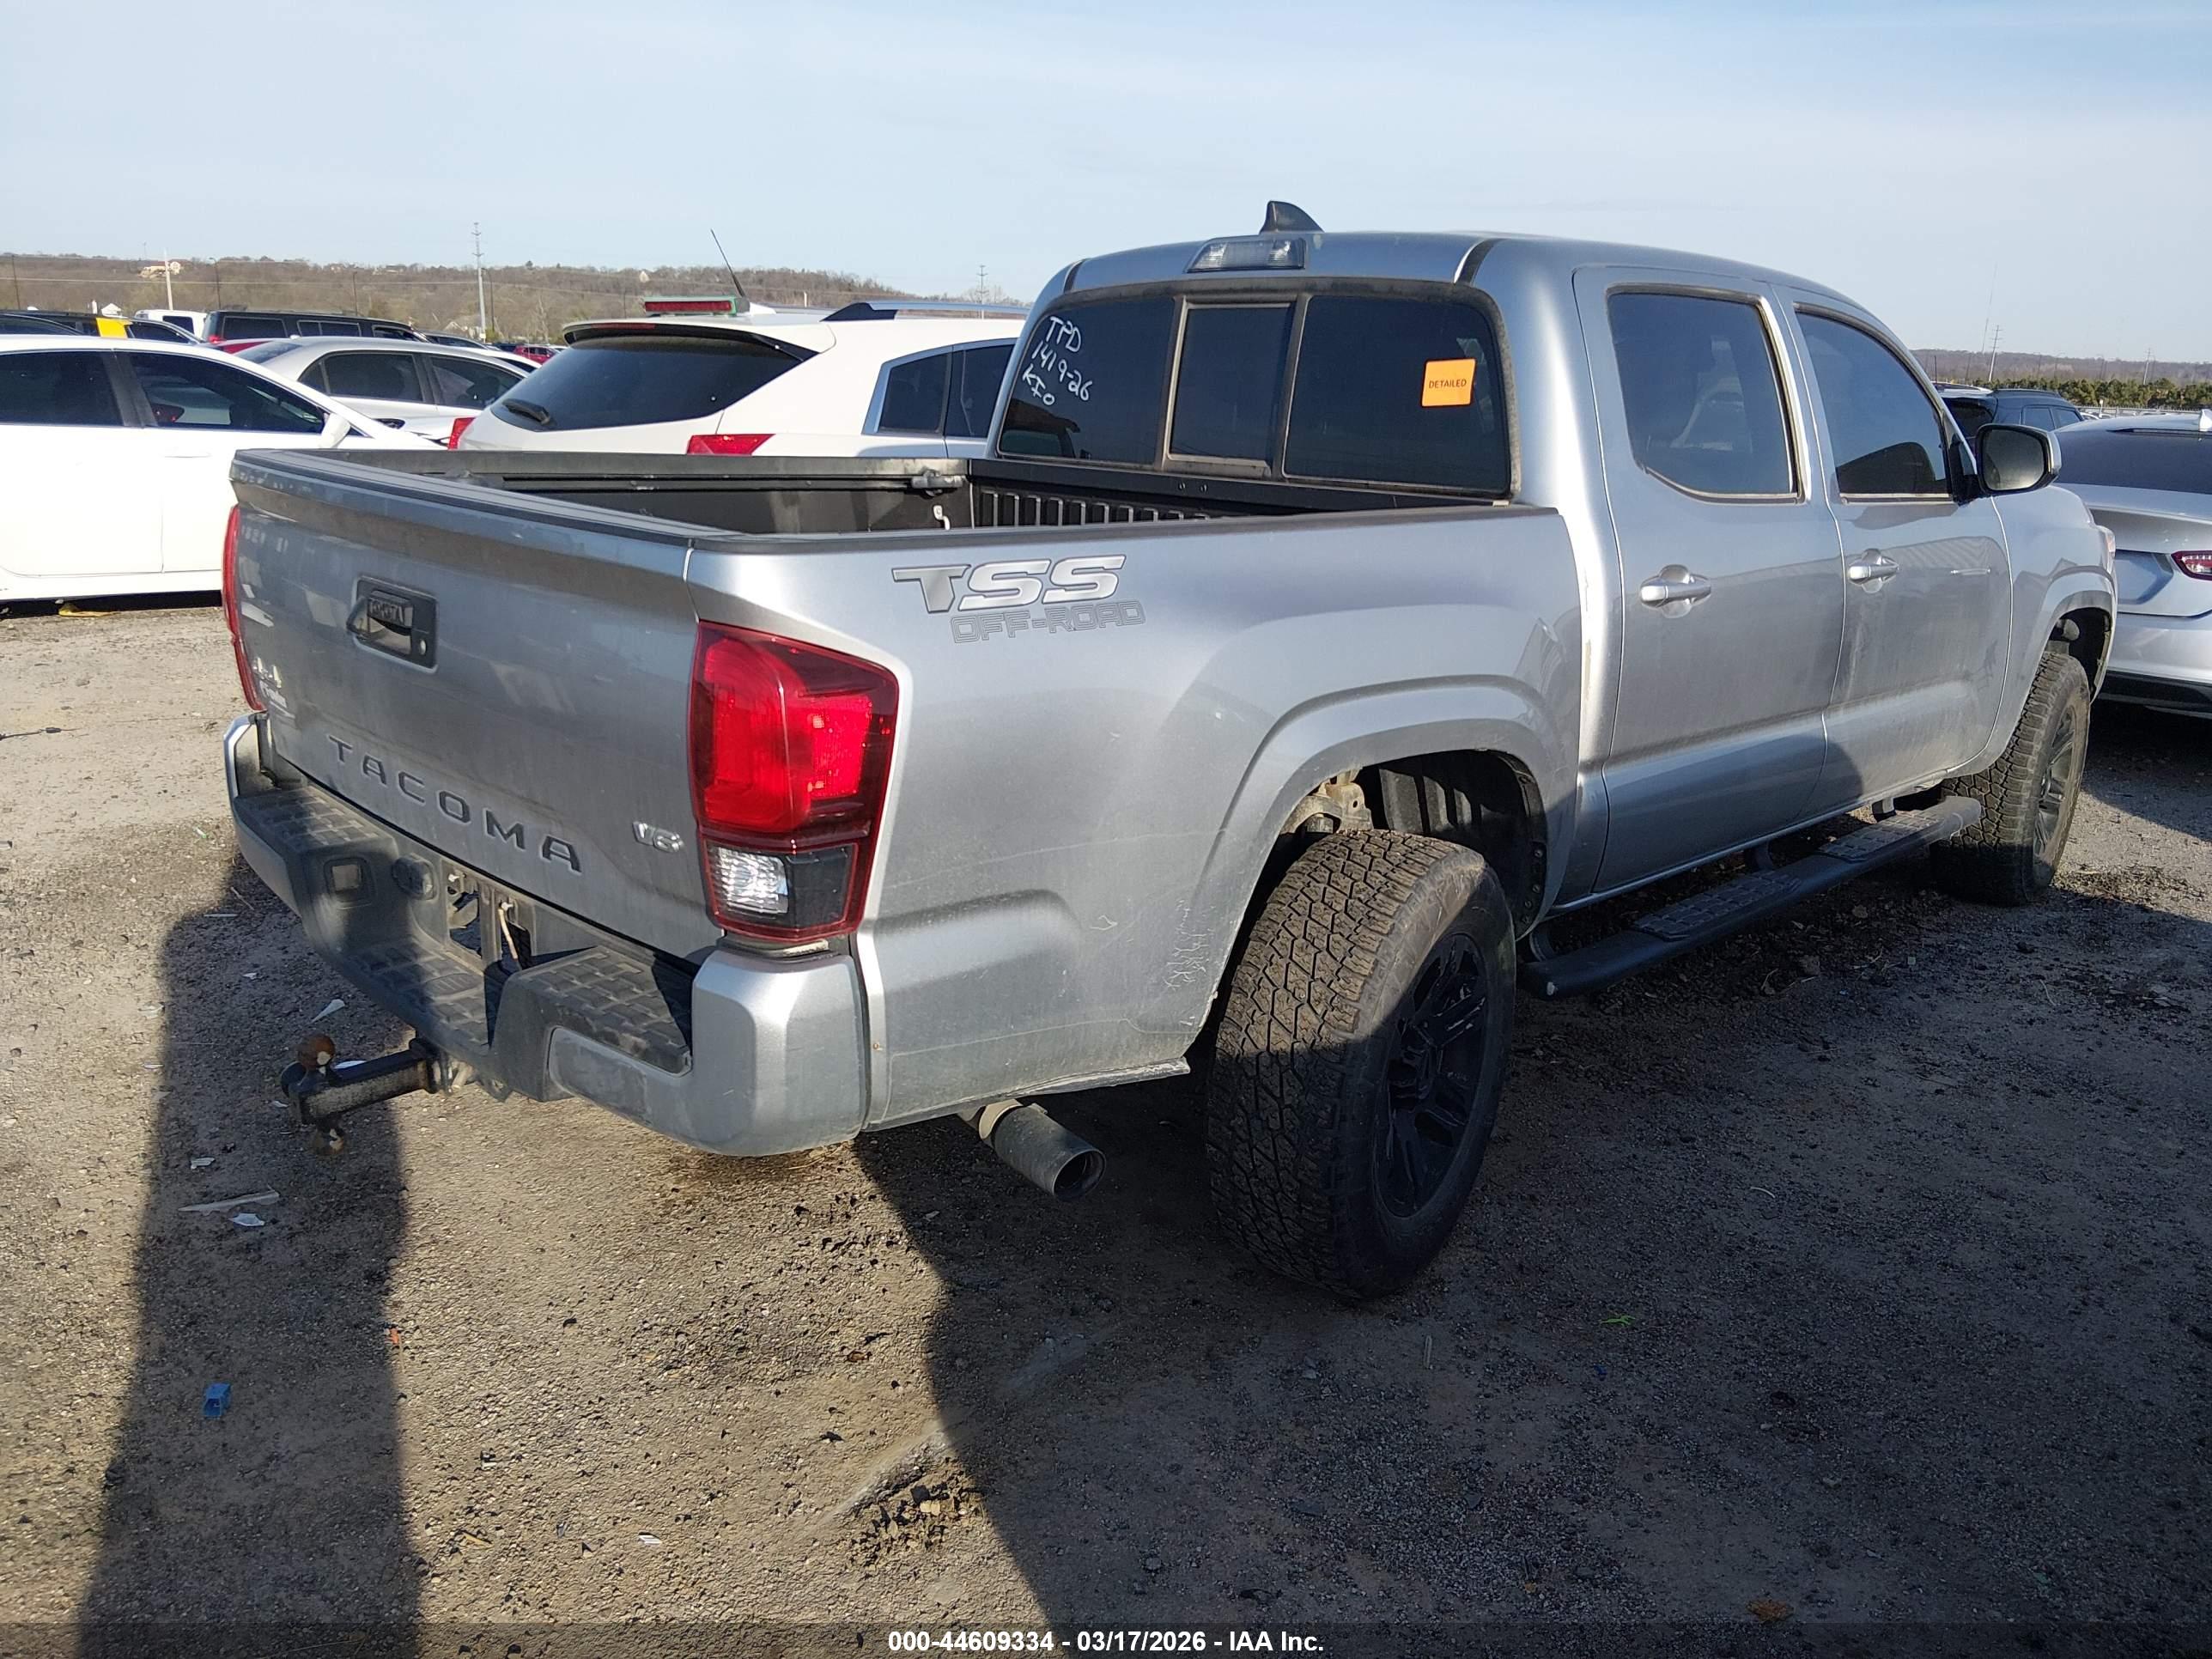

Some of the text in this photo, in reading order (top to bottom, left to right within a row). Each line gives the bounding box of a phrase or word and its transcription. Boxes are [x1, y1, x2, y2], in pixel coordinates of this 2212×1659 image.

[1046, 315, 1082, 353] TPD
[1031, 340, 1093, 401] 1419-26
[1428, 379, 1468, 389] DETAILED
[891, 554, 1127, 614] TSS
[950, 601, 1146, 644] OFF-ROAD
[327, 735, 582, 873] TACOMA
[632, 821, 684, 853] V6
